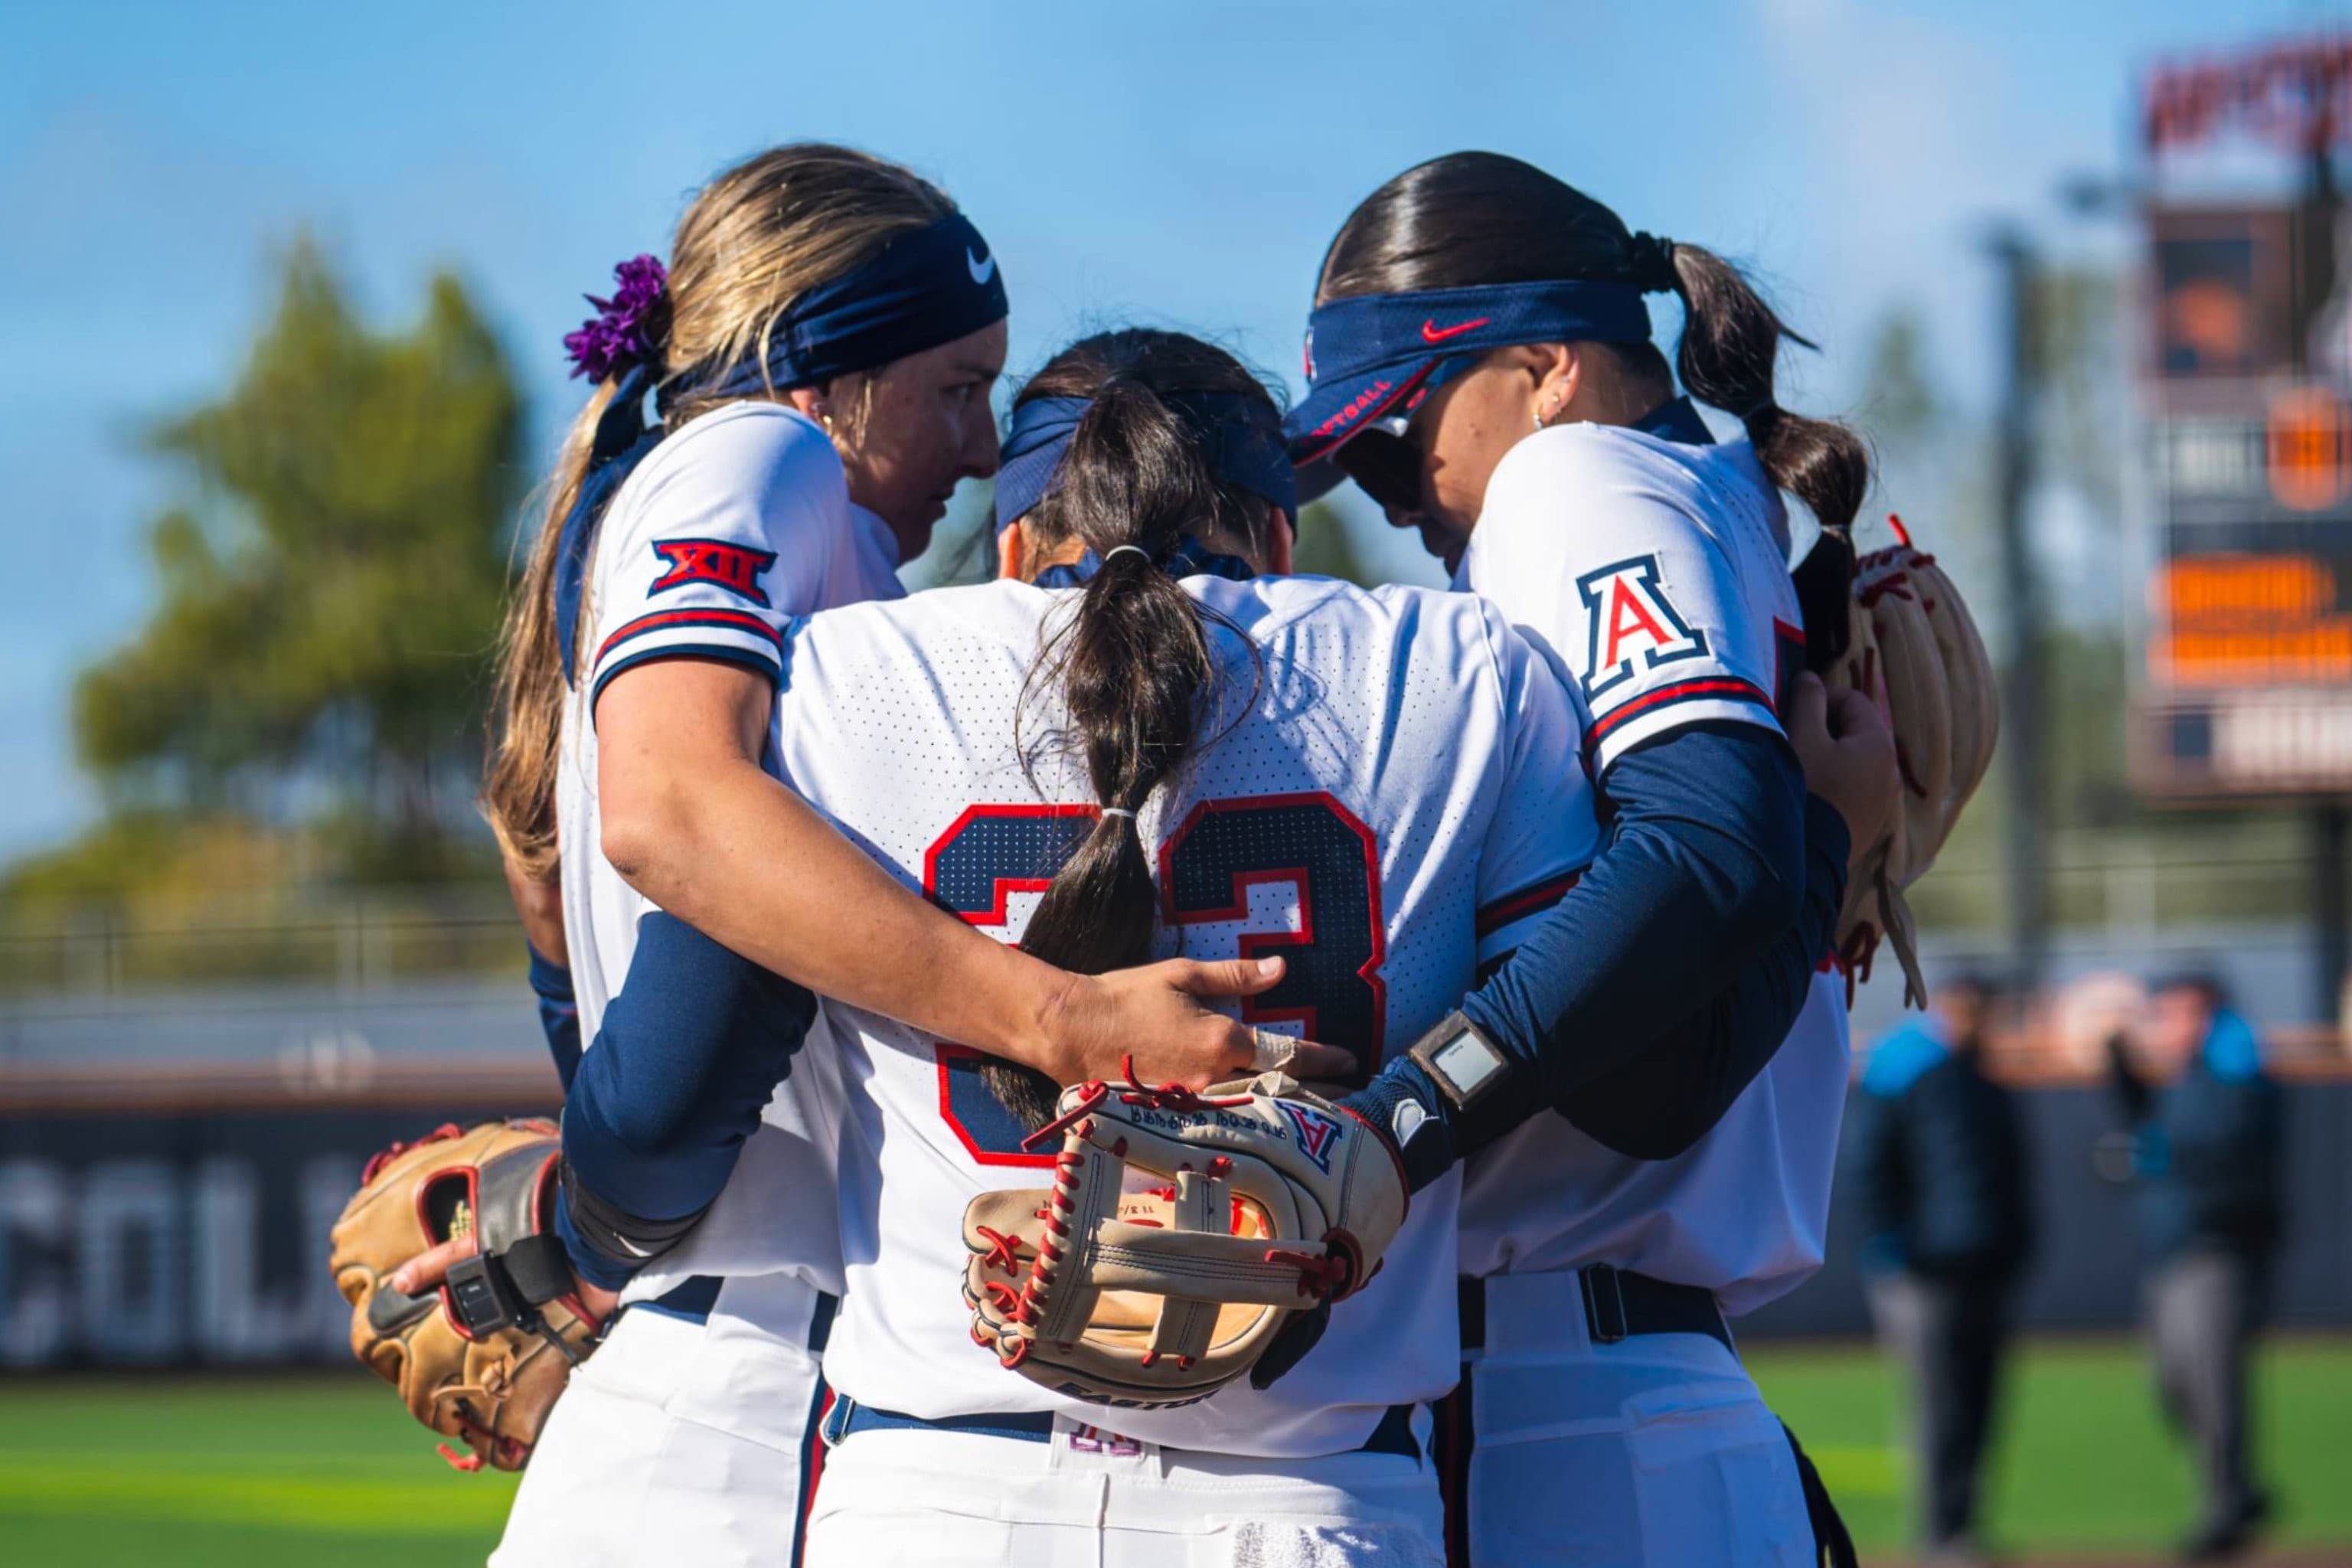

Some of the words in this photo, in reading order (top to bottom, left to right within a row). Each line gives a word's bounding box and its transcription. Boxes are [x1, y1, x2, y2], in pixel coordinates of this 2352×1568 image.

[647, 537, 779, 609] XII
[1576, 553, 1711, 706] A
[1274, 1099, 1343, 1175] A
